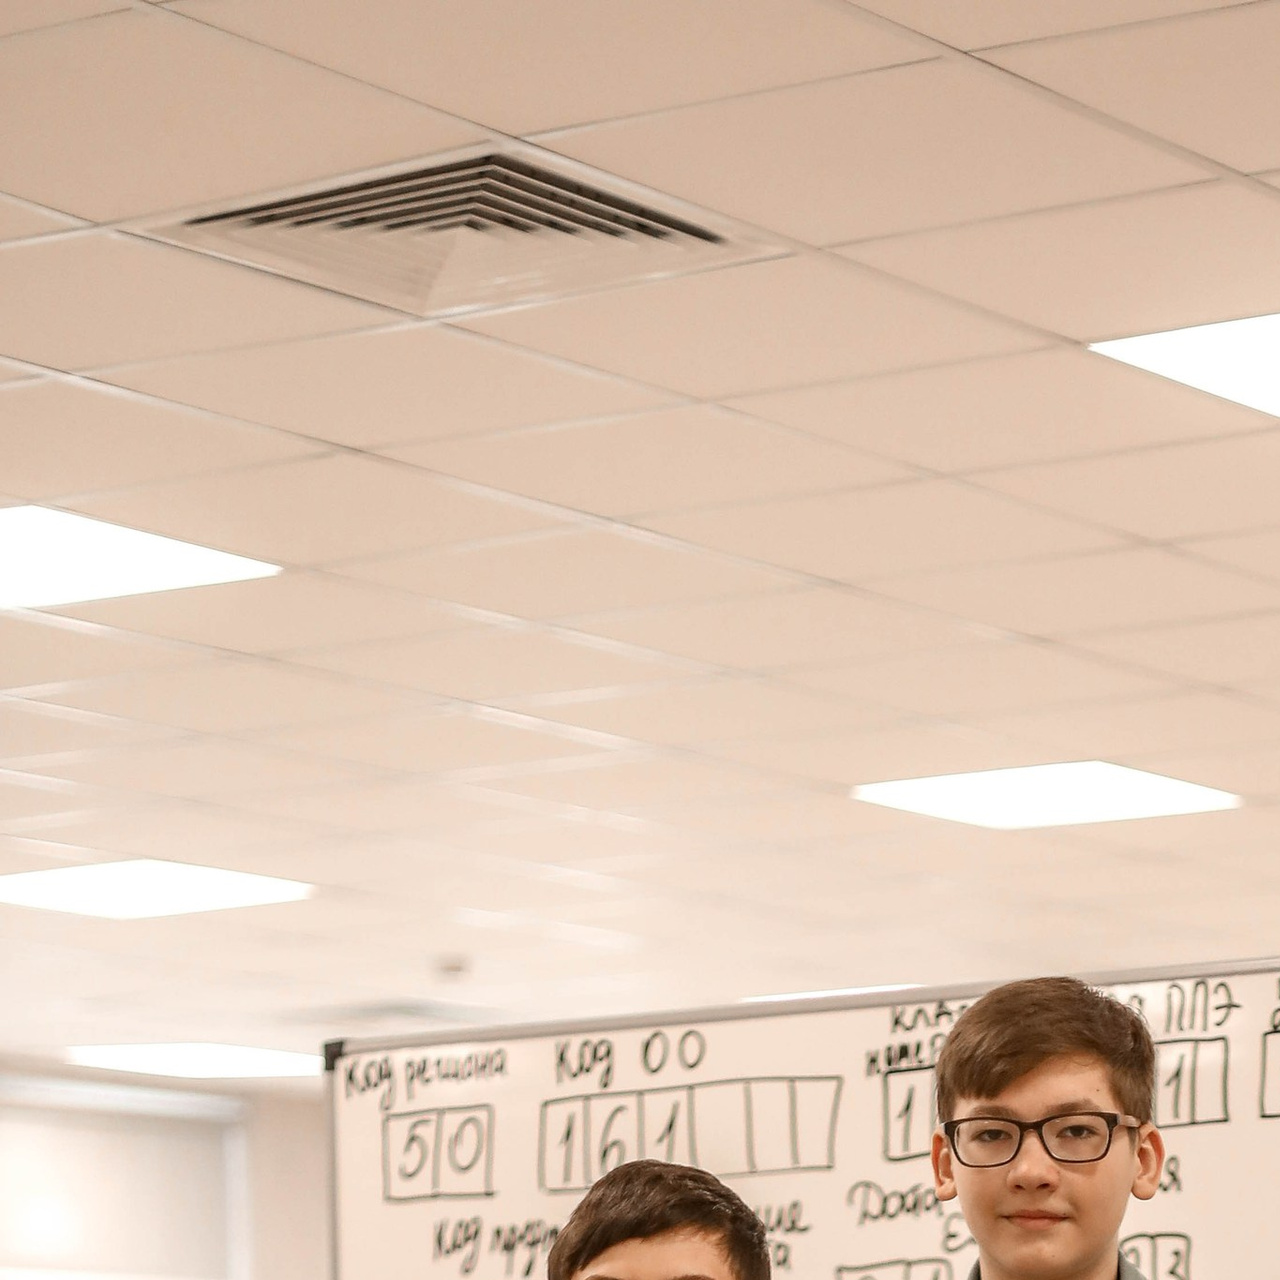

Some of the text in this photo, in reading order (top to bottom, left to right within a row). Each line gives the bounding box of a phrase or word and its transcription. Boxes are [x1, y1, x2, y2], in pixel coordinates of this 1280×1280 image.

[345, 1055, 397, 1111] Код
[555, 1038, 614, 1088] Код
[432, 1216, 482, 1276] Код
